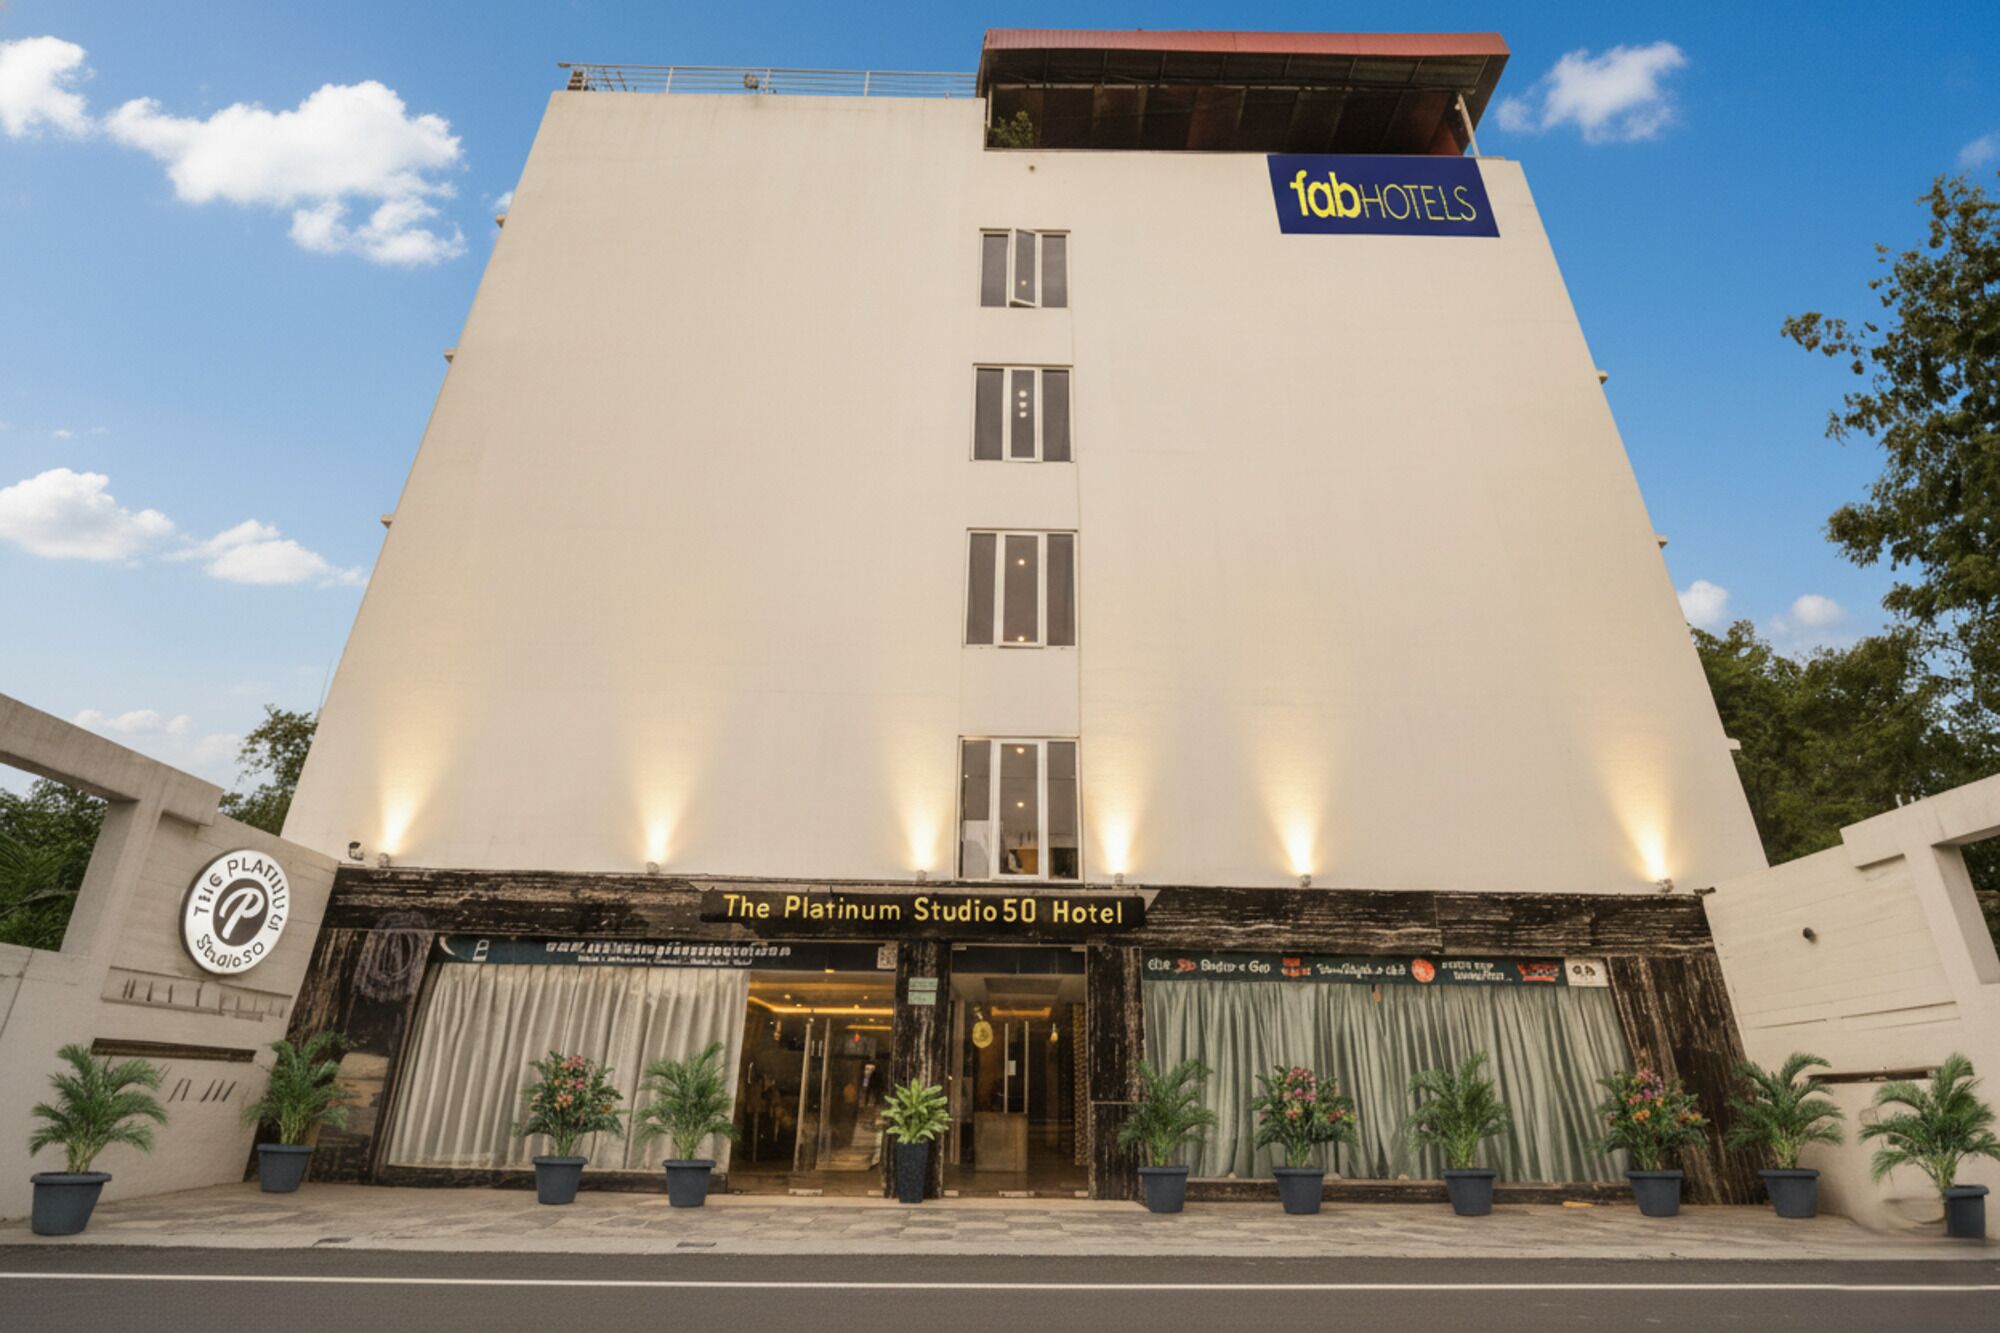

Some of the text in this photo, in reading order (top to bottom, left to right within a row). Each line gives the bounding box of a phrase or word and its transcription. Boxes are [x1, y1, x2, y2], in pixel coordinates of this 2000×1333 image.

[723, 894, 770, 918] The
[784, 895, 901, 920] Platinum
[1052, 900, 1123, 924] Hotel
